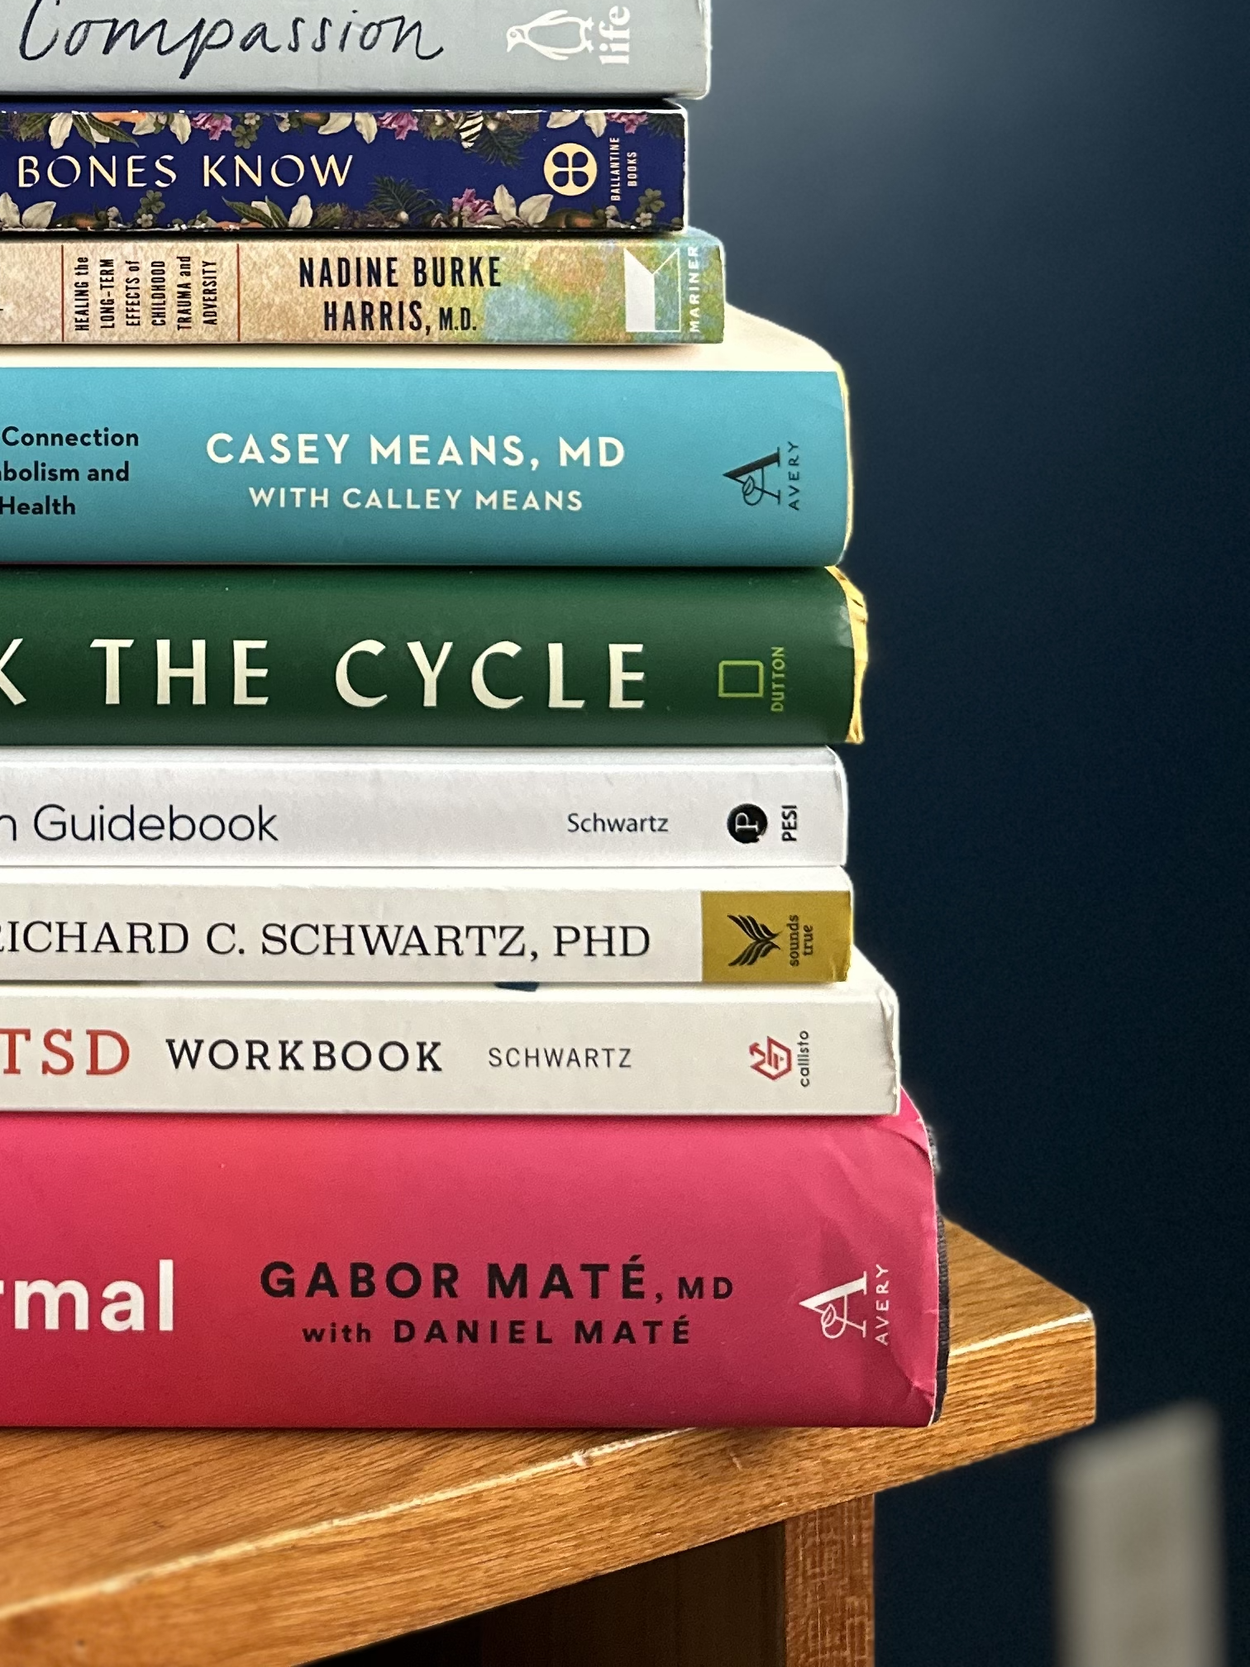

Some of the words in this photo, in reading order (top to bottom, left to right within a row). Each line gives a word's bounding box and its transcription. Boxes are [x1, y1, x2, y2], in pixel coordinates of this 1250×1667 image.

[18, 154, 177, 188] BONES
[203, 154, 353, 188] KNOW
[609, 137, 621, 201] BALLANTINE
[626, 151, 638, 187] BOOKS
[73, 256, 89, 276] the
[124, 260, 141, 272] of
[176, 255, 192, 276] and
[299, 256, 399, 288] NADINE
[413, 256, 502, 288] BURKE
[73, 281, 90, 331] HEALING
[99, 258, 116, 329] LONG-TERM
[125, 277, 141, 327] EFFECTS
[150, 260, 167, 327] CHILDHOOD
[176, 282, 193, 332] TRAUMA
[201, 260, 218, 326] ADVERSITY
[323, 299, 431, 337] HARRIS,
[439, 306, 477, 331] M.D.
[1, 425, 139, 447] Connection
[206, 432, 350, 465] CASEY
[369, 434, 539, 471] MEANS,
[559, 436, 625, 467] MD
[87, 460, 130, 482] and
[787, 441, 800, 512] AVERY
[248, 486, 329, 508] WITH
[342, 487, 463, 510] CALLEY
[475, 489, 583, 512] MEANS
[89, 638, 269, 705] THE
[335, 639, 645, 709] CYCLE
[770, 646, 786, 712] DUTTON
[33, 803, 279, 842] Guidebook
[567, 812, 669, 833] Schwartz
[781, 804, 798, 842] PESI
[206, 922, 245, 955] C.
[261, 922, 538, 962] SCHWARTZ,
[553, 925, 650, 957] PHD
[786, 914, 800, 967] sounds
[802, 924, 814, 957] true
[165, 1038, 443, 1072] WORKBOOK
[488, 1047, 632, 1069] SCHWARTZ
[260, 1260, 459, 1299] GABOR
[487, 1254, 663, 1304] MATÉ,
[678, 1276, 734, 1300] MD
[874, 1263, 890, 1346] AVERY
[301, 1321, 372, 1343] with
[394, 1319, 553, 1345] DANIEL
[574, 1314, 690, 1345] MATÉ
